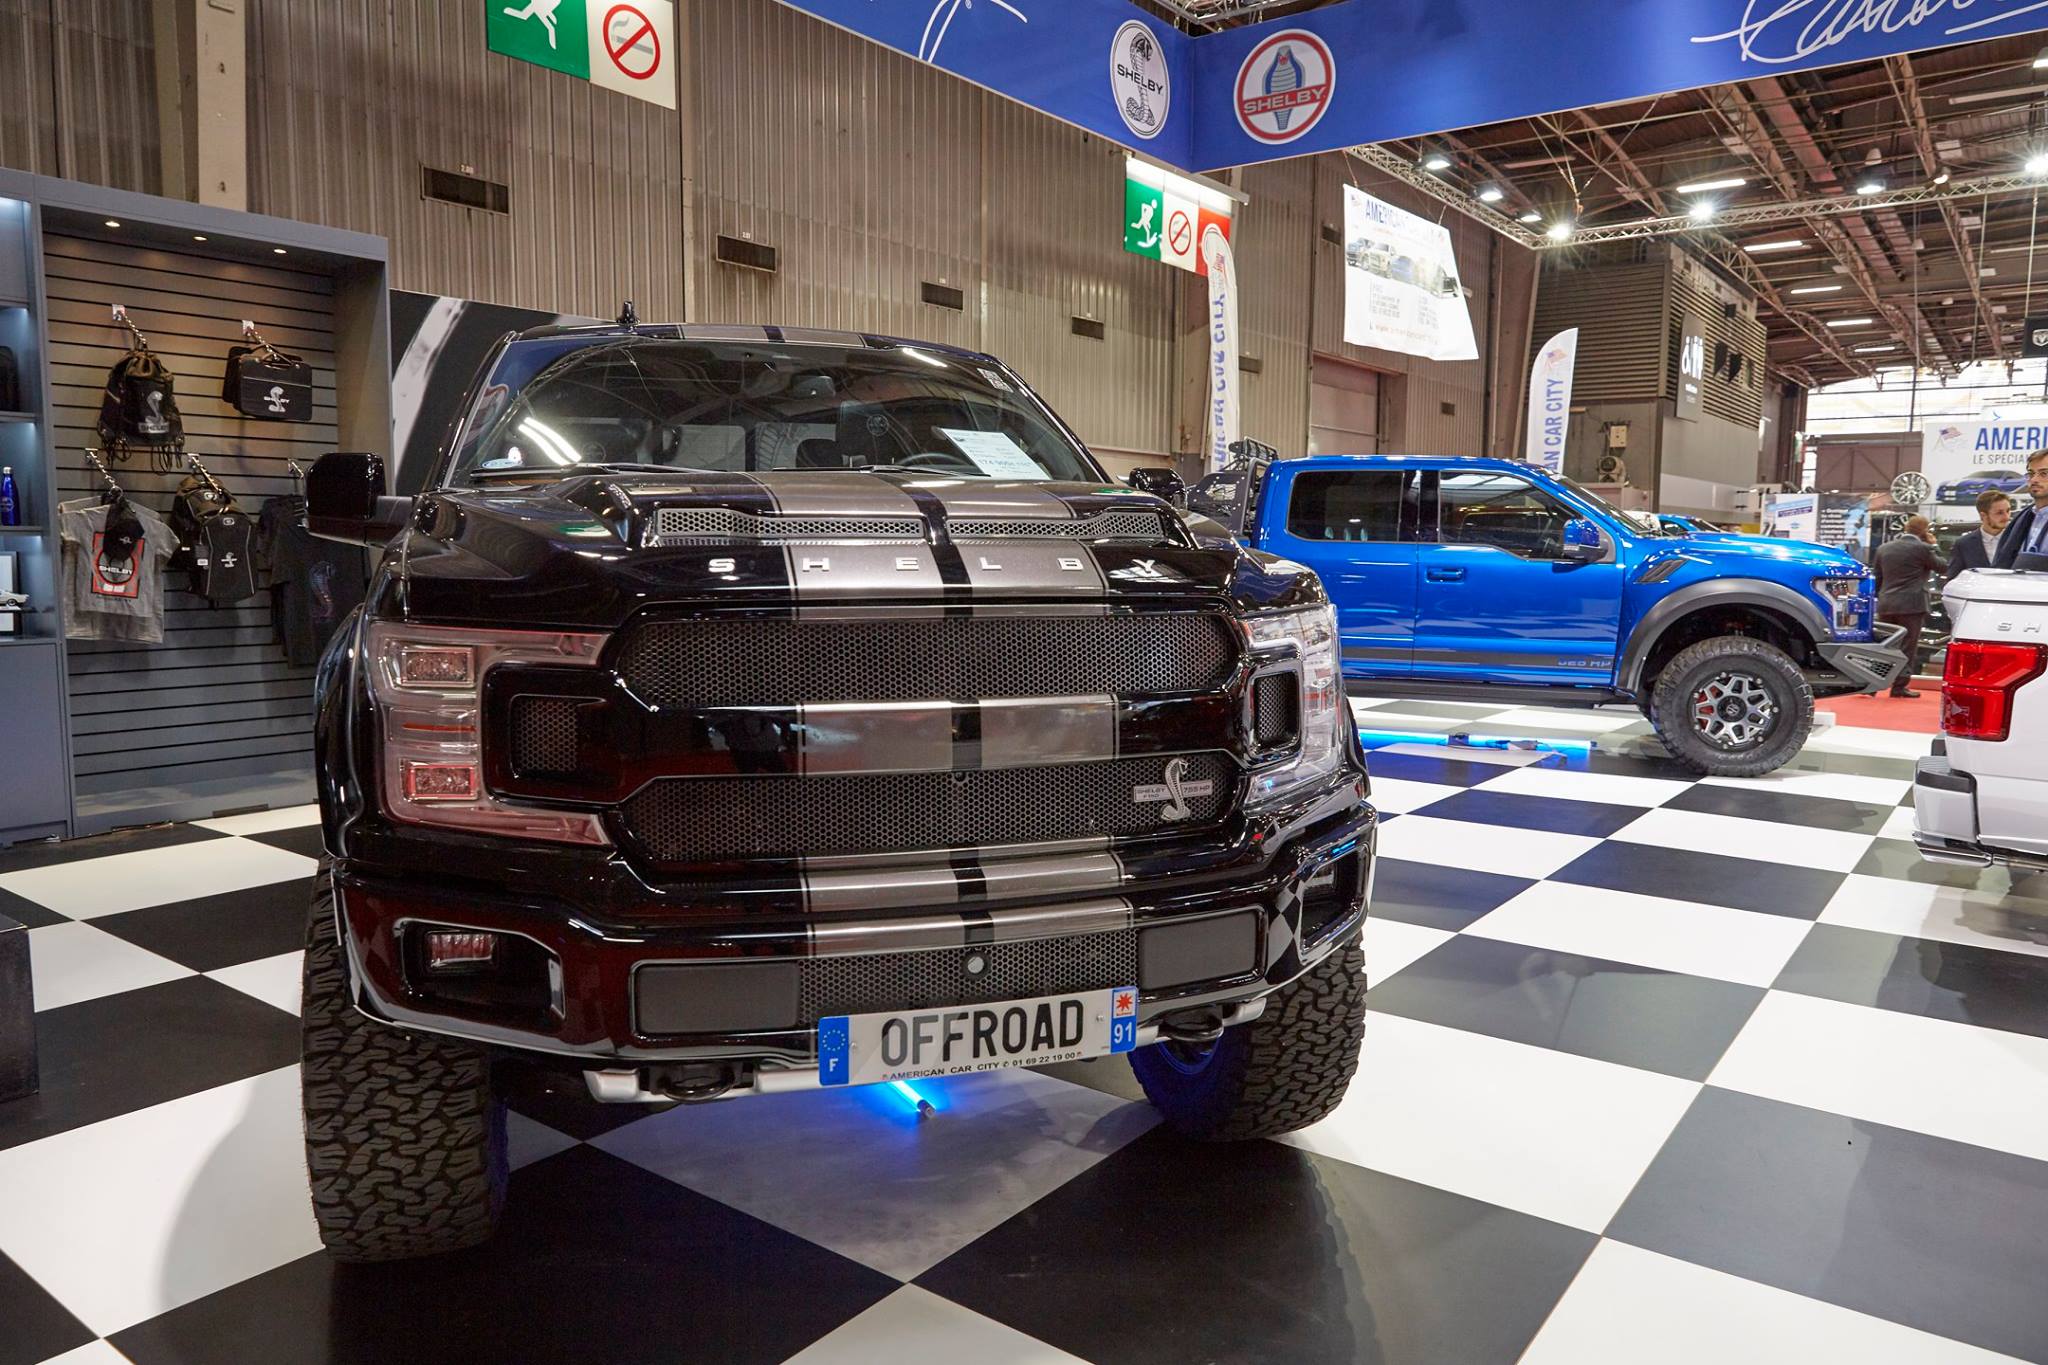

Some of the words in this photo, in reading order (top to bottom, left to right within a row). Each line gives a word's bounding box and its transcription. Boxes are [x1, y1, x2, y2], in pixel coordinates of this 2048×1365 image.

[1117, 64, 1164, 96] SHELBY
[1243, 86, 1326, 115] SHELBY
[1546, 378, 1564, 412] CITY
[1544, 416, 1562, 446] CAR
[1973, 454, 1983, 465] LE
[99, 565, 133, 576] SHELBY
[708, 557, 1156, 575] SHELBY
[881, 1000, 1084, 1067] OFFROAD
[1114, 1021, 1133, 1044] 91
[828, 1058, 839, 1073] F
[890, 1068, 945, 1080] AMERICAN
[950, 1065, 972, 1074] CAR
[977, 1061, 999, 1071] CITY
[1064, 1052, 1076, 1060] 00
